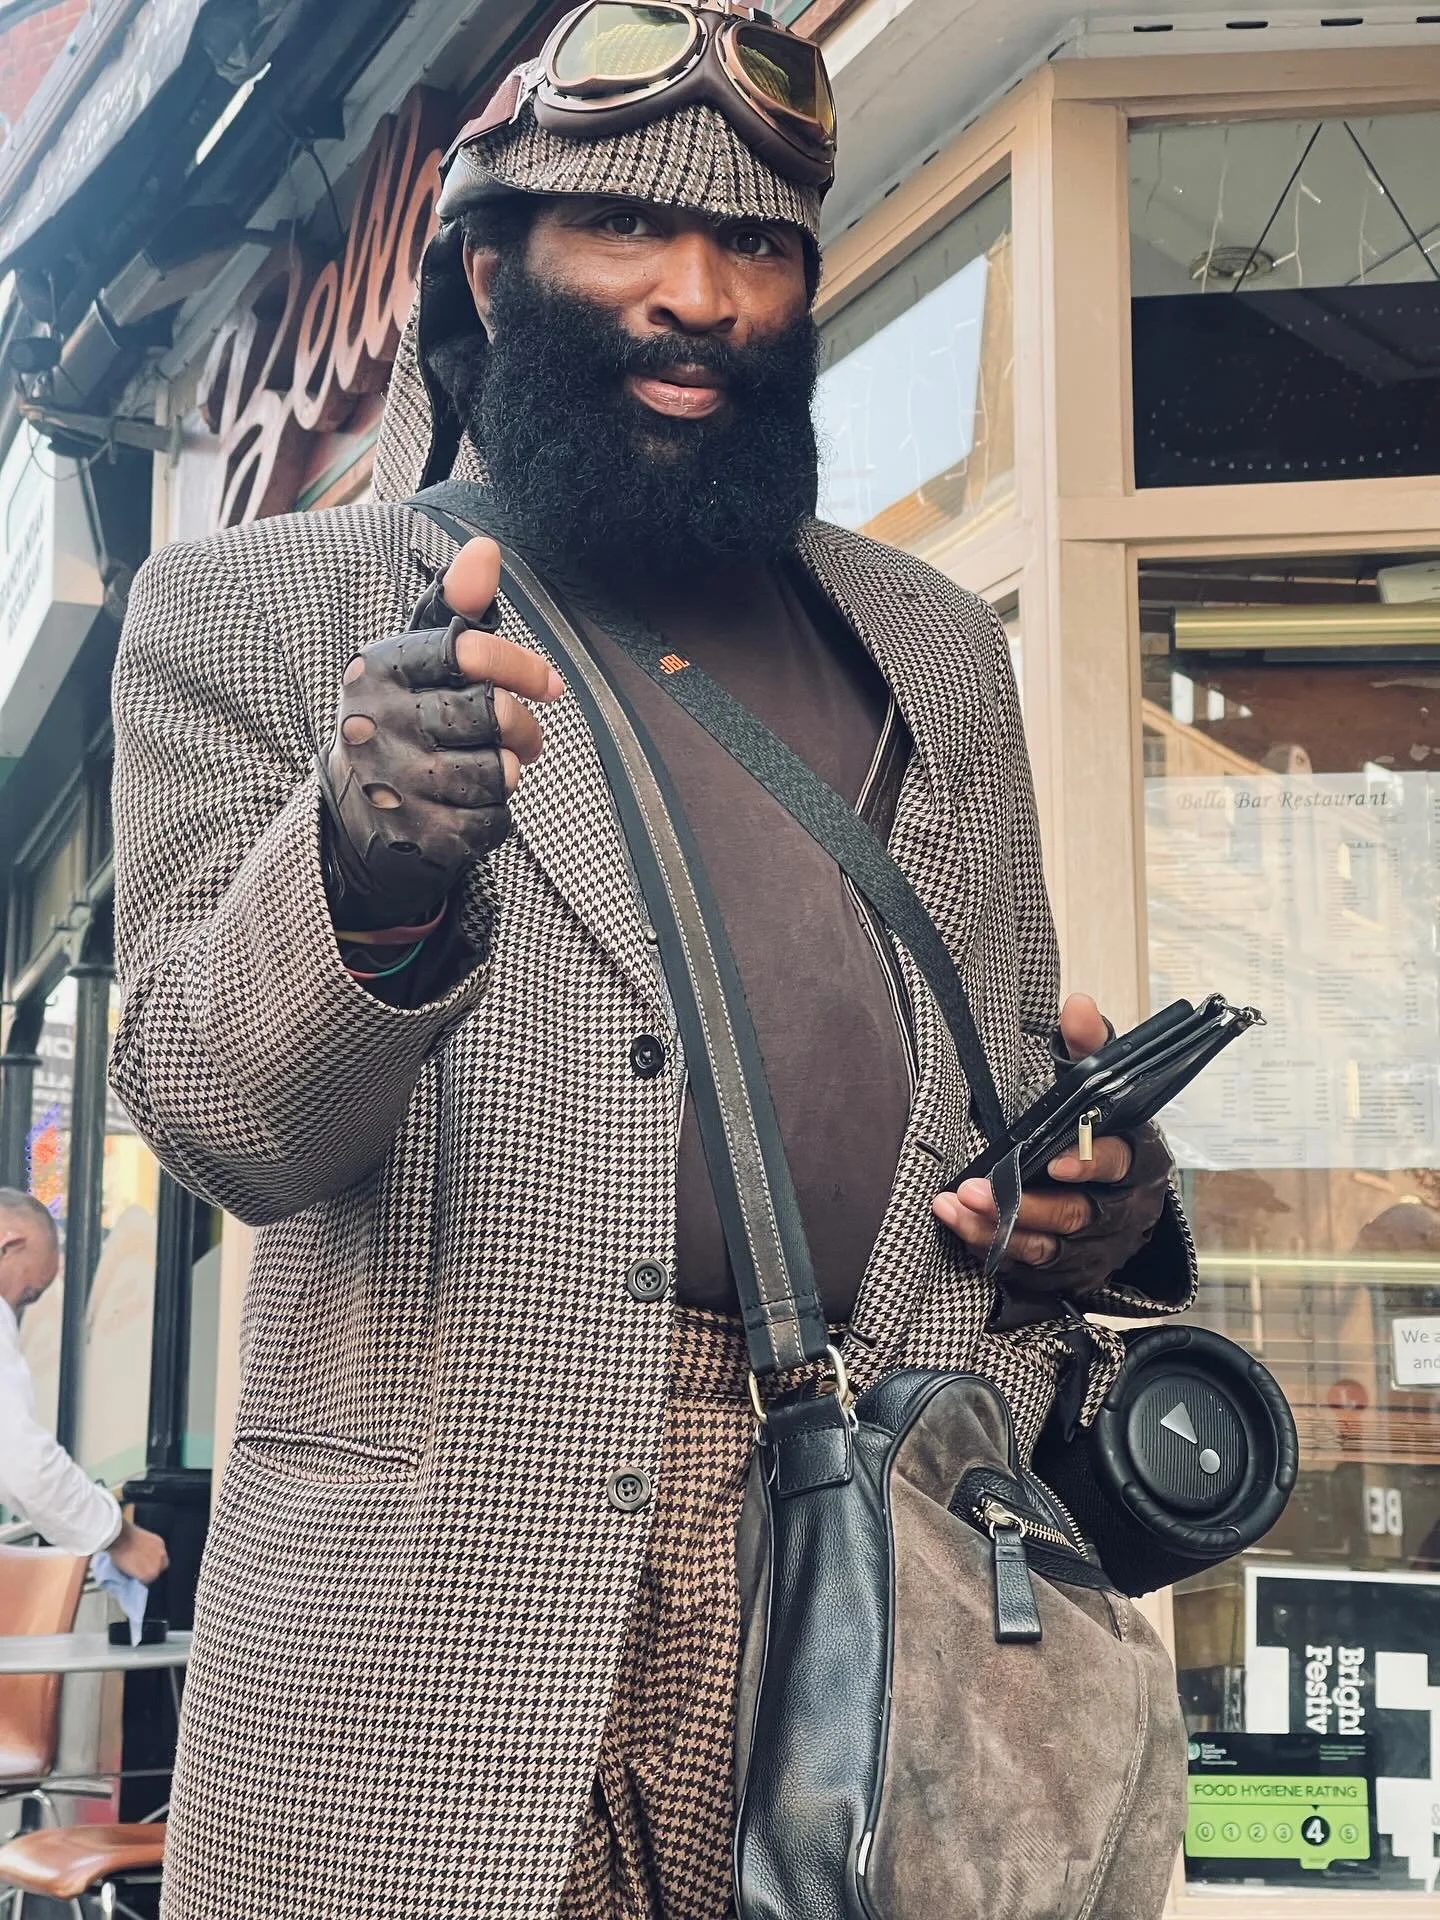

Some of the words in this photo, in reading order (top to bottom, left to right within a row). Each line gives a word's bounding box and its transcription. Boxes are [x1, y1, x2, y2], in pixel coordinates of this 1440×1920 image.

[1234, 790, 1272, 809] Bar
[1279, 790, 1388, 811] Restaurant
[1401, 1329, 1430, 1344] We
[1194, 1784, 1237, 1797] FOOD
[1241, 1784, 1301, 1798] HYGIENE
[1305, 1785, 1358, 1798] RATING
[1306, 1818, 1325, 1843] 4
